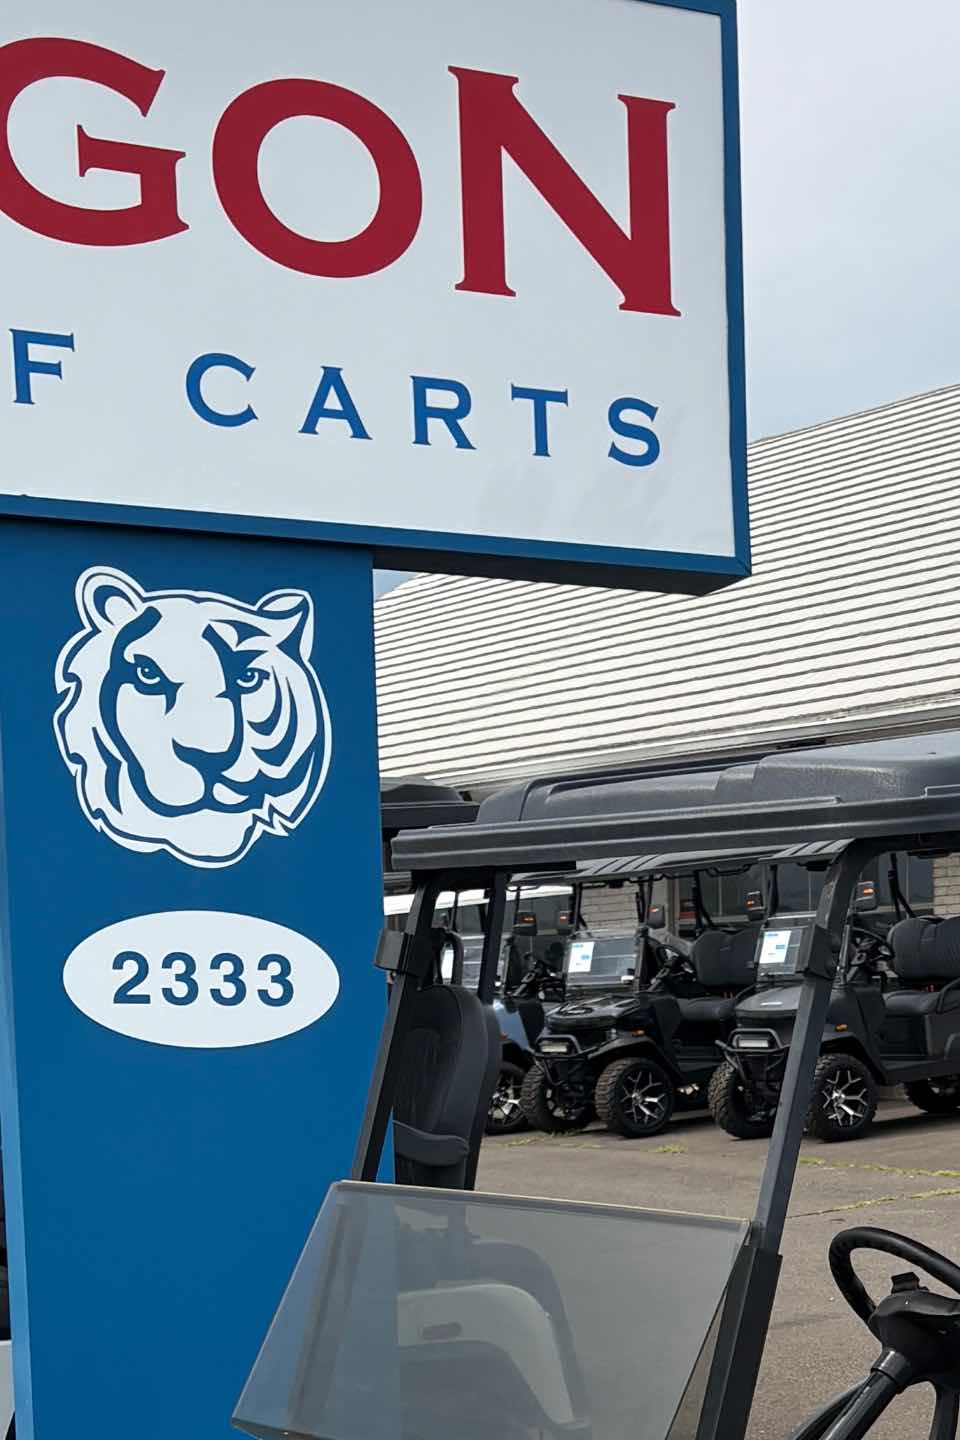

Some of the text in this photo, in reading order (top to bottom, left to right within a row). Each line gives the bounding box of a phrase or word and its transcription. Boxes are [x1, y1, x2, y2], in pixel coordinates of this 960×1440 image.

[0, 37, 682, 317] GON
[8, 328, 661, 468] F CARTS
[111, 951, 295, 1007] 2333
